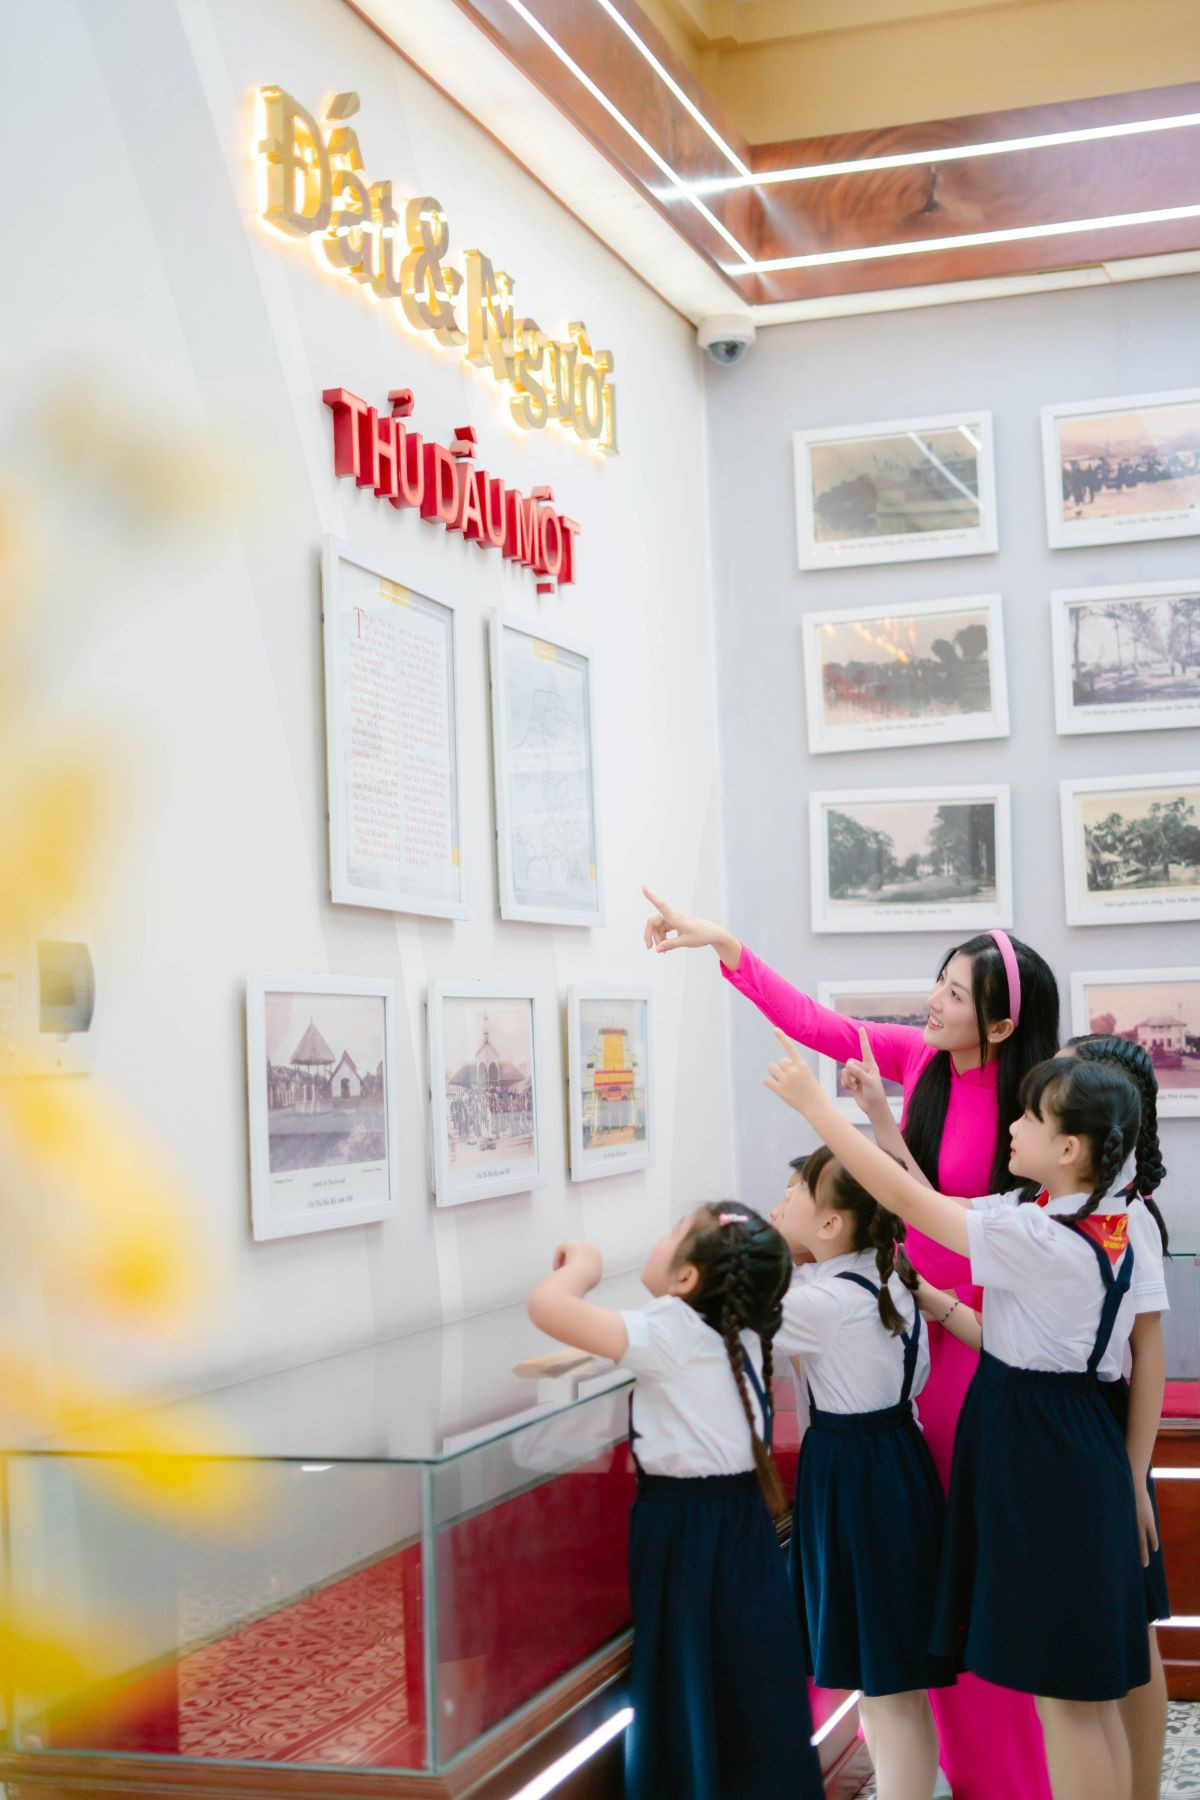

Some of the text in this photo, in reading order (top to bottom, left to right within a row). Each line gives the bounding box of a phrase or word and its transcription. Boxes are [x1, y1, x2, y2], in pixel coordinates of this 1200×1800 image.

[258, 85, 401, 298] Đất
[400, 196, 465, 345] &
[322, 387, 424, 510] THỦ
[502, 485, 581, 594] MỘT
